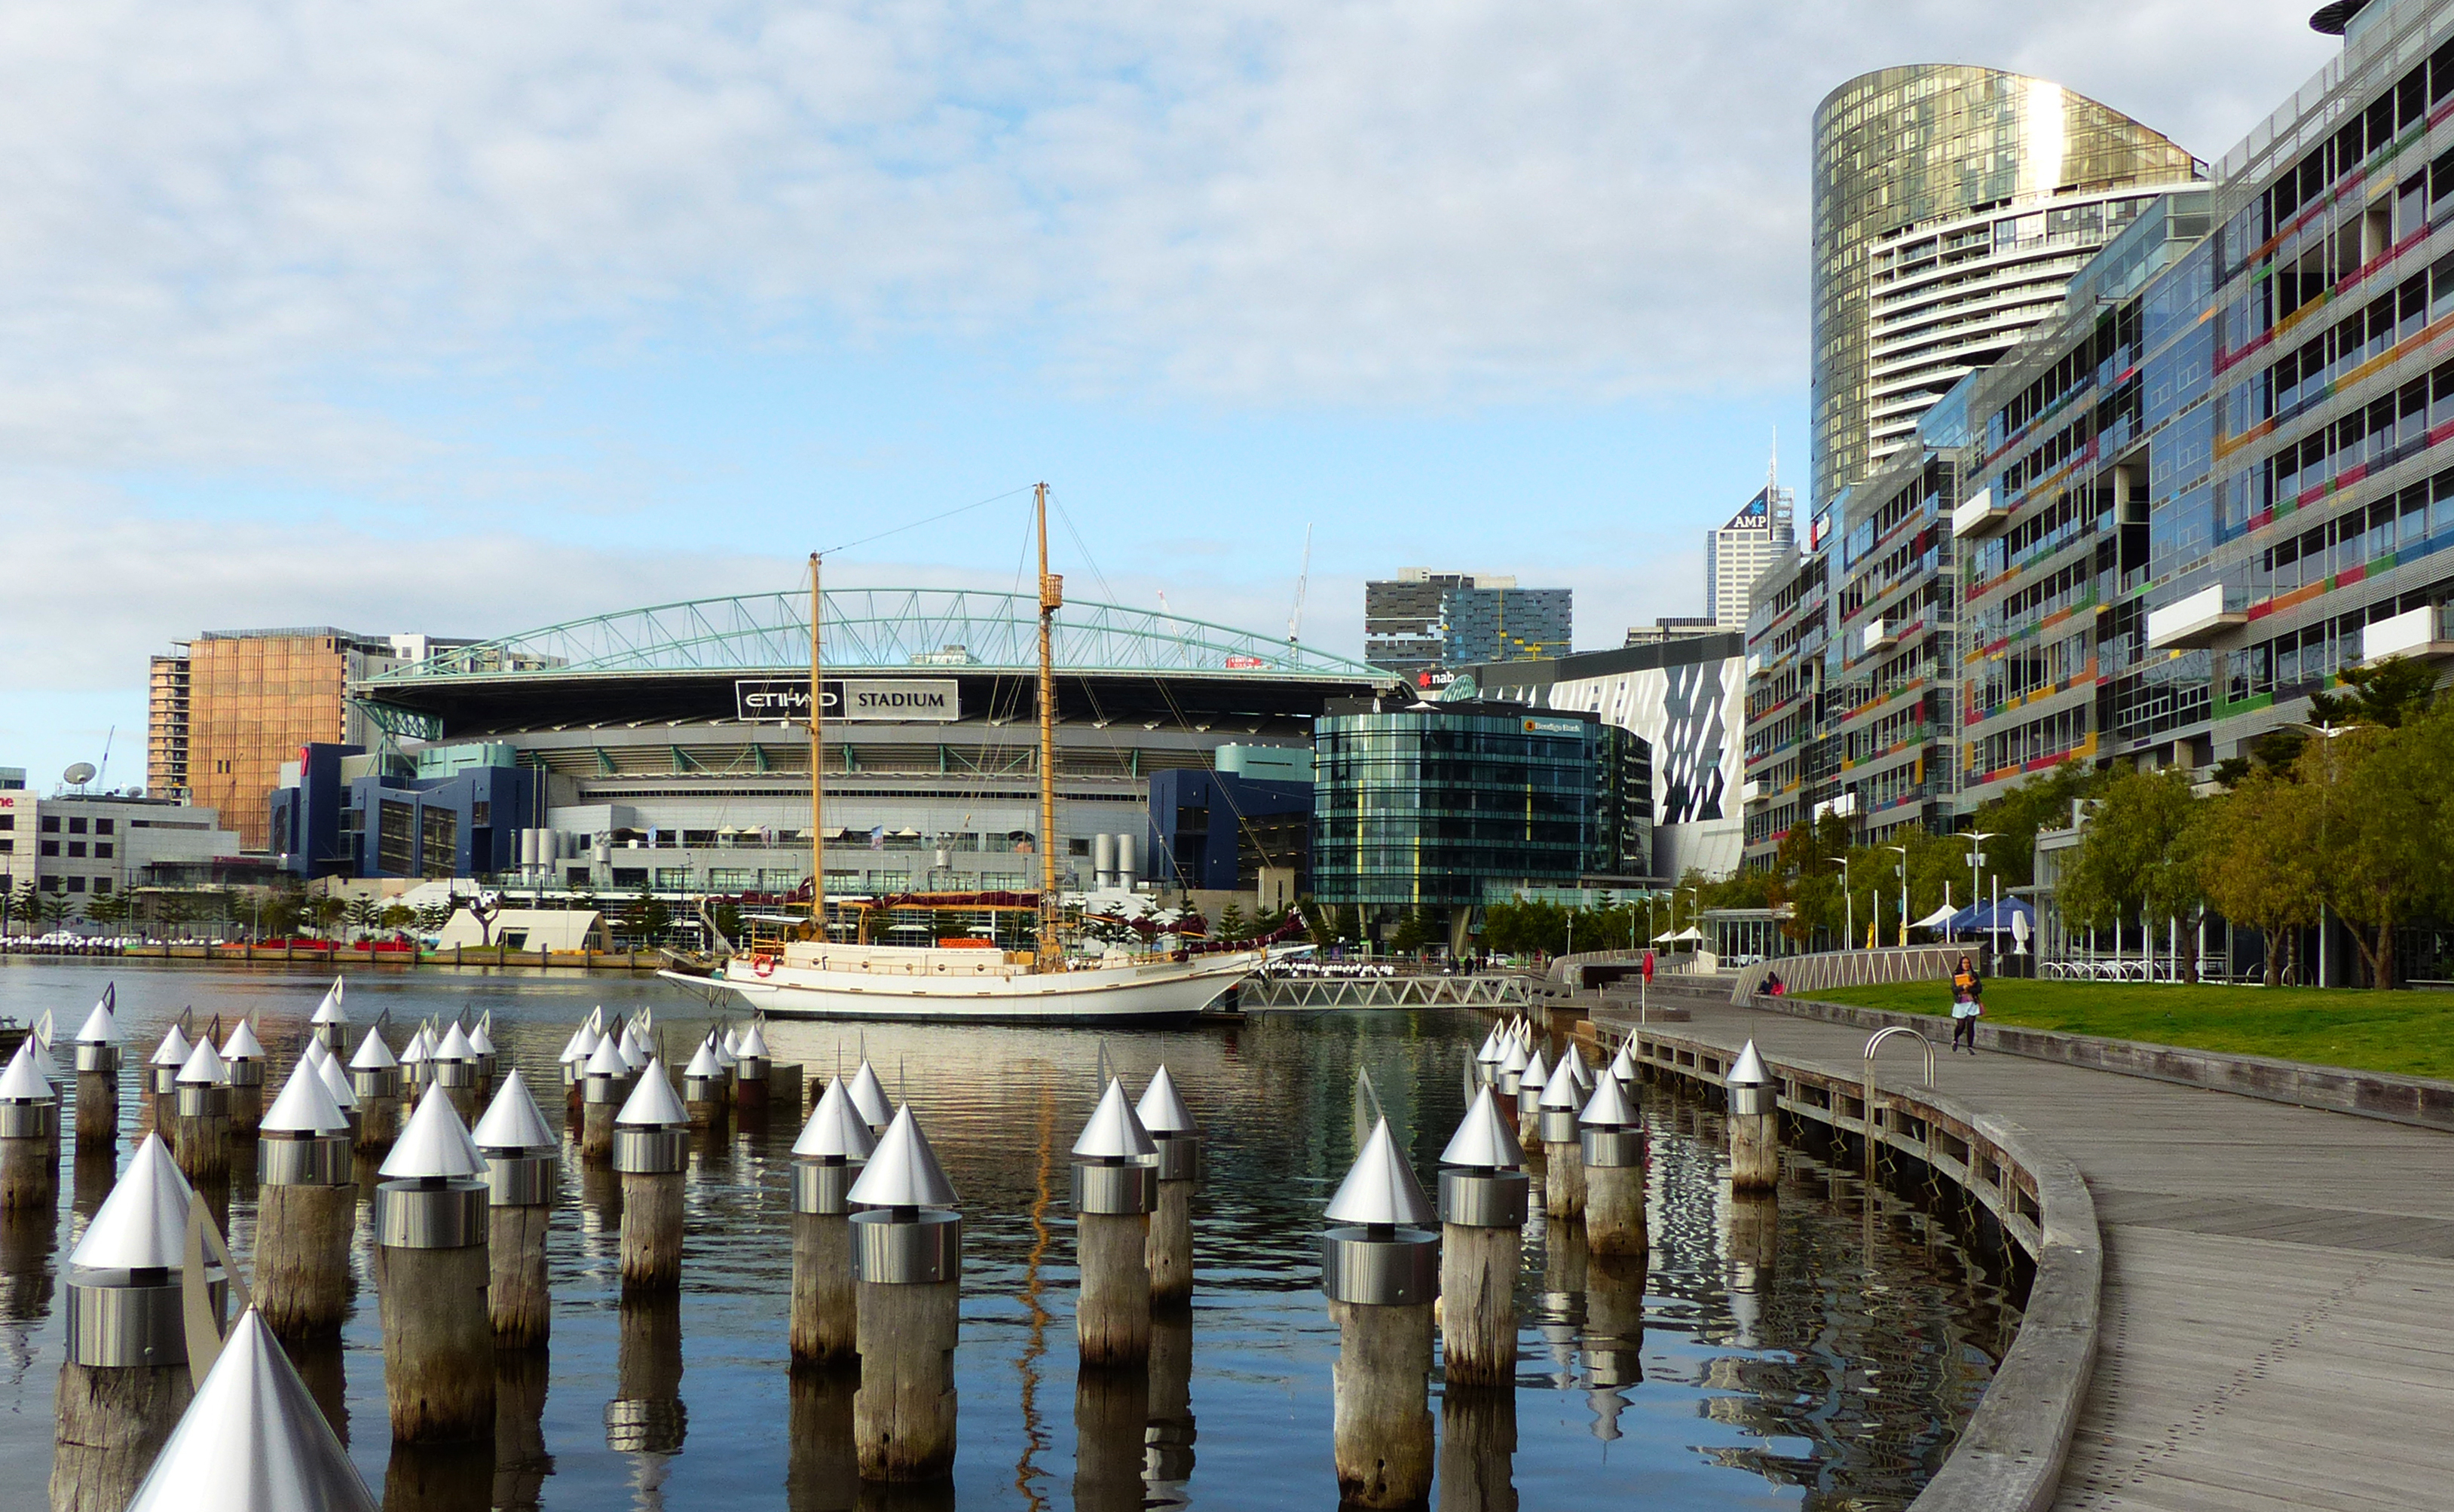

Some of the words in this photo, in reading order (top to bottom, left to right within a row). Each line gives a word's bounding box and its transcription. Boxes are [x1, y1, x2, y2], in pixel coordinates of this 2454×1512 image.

[1733, 516, 1767, 528] AMP
[1432, 671, 1455, 684] nab
[858, 693, 944, 707] STADIUM
[1535, 722, 1562, 733] Bendigo
[1562, 724, 1580, 732] Bank
